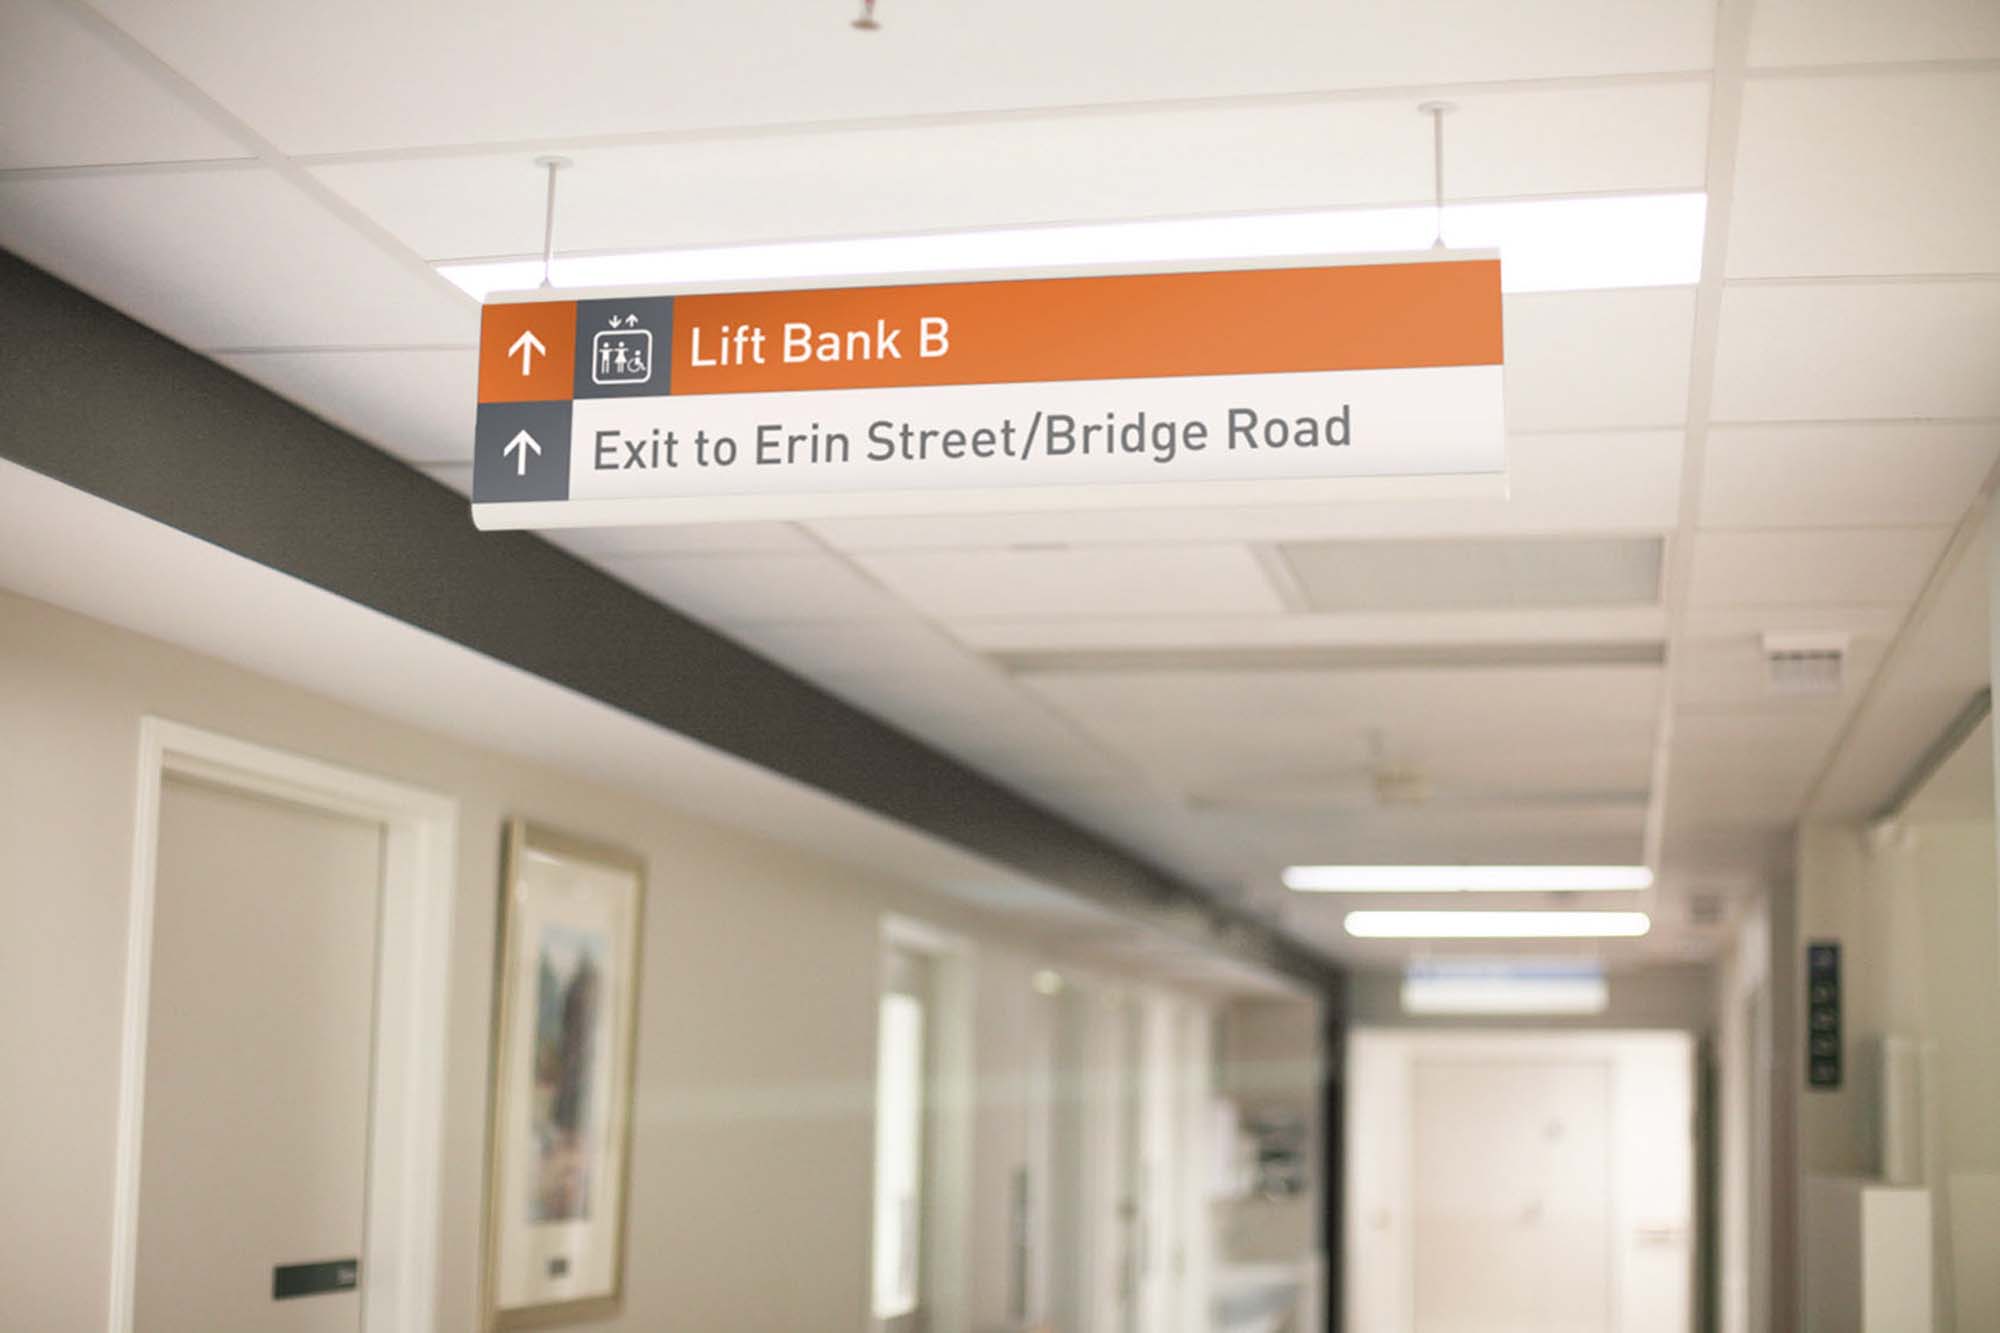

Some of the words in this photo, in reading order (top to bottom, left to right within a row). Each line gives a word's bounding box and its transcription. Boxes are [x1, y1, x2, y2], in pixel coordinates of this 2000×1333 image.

[691, 324, 766, 367] Lift
[783, 319, 902, 363] Bank
[919, 316, 949, 358] B
[594, 428, 679, 471] Exit
[694, 430, 737, 467] to
[756, 422, 849, 466] Erin
[867, 411, 1208, 464] Street/Bridge
[1228, 404, 1351, 450] Road
